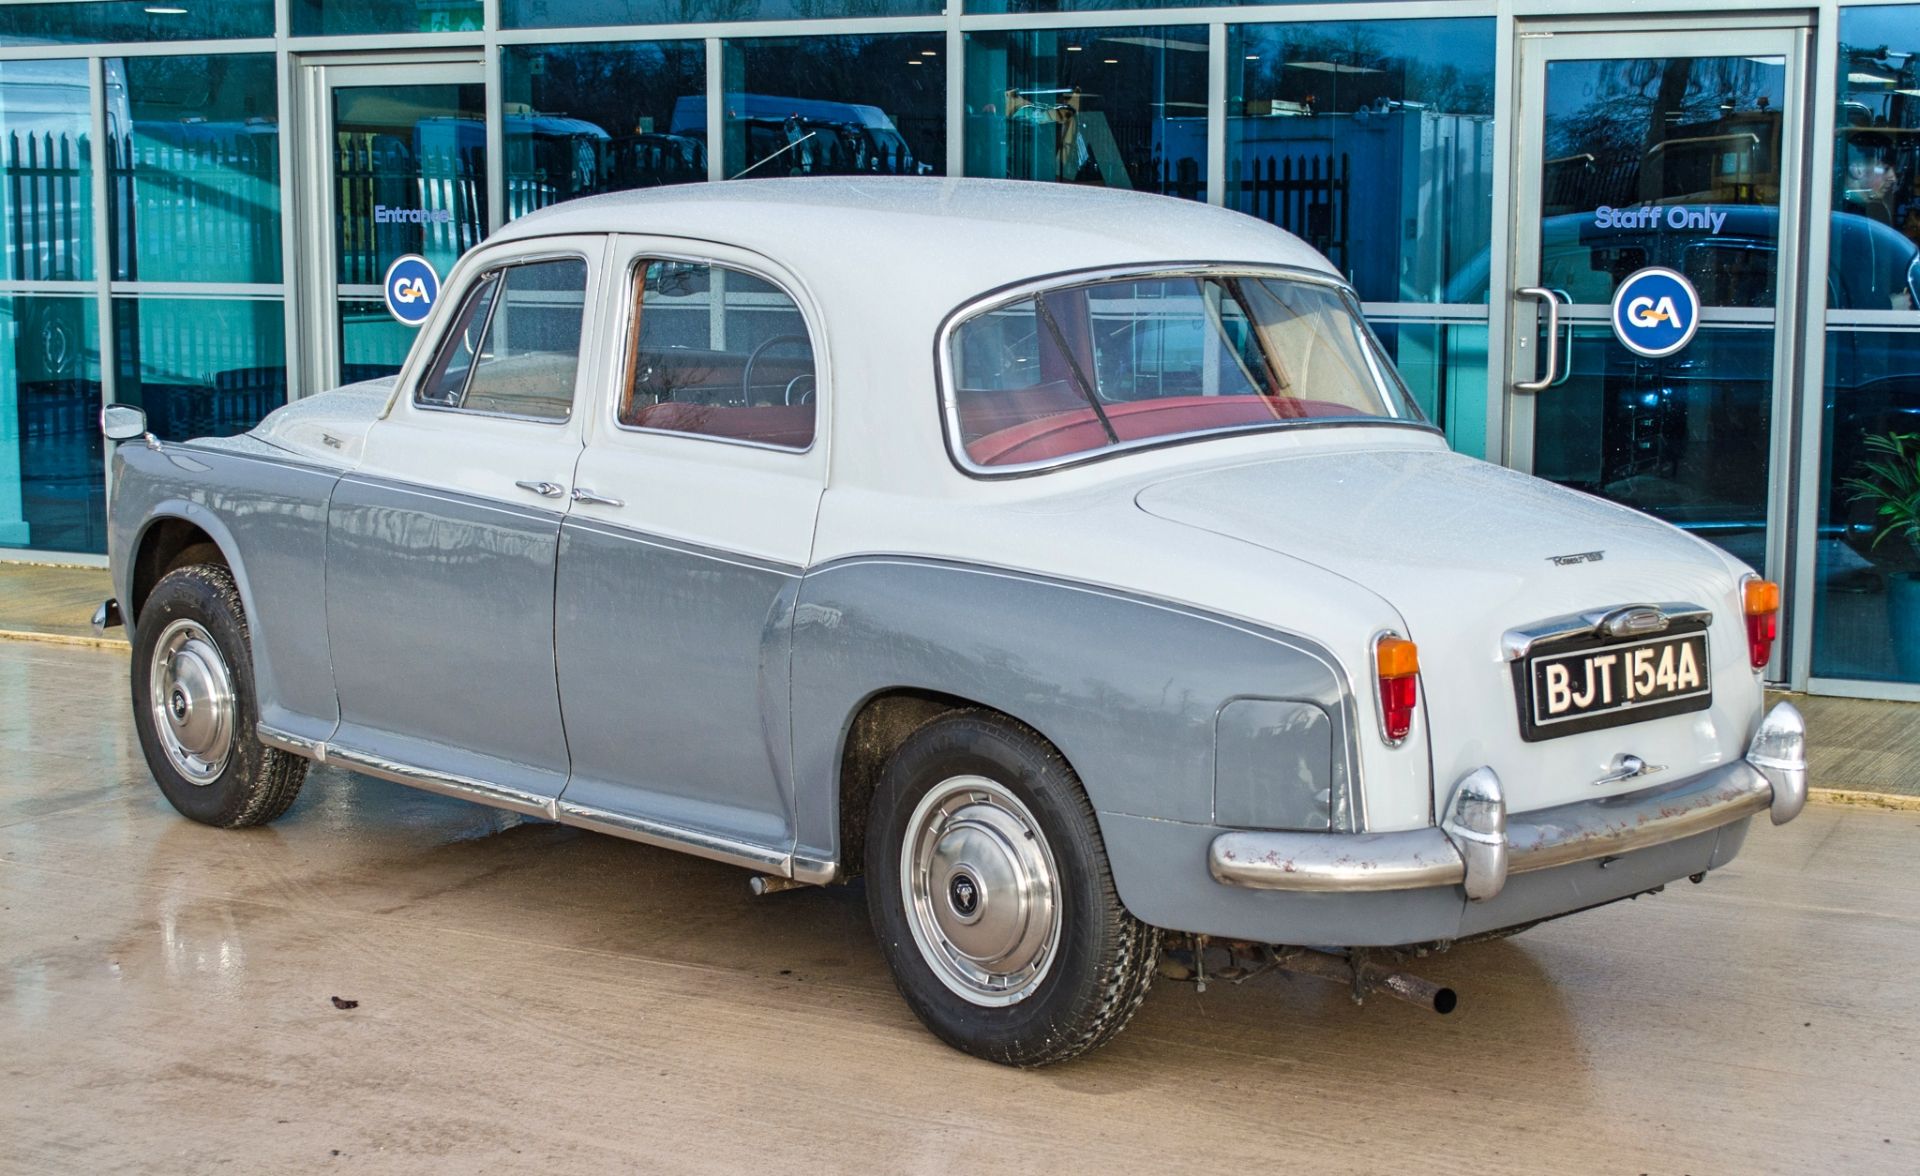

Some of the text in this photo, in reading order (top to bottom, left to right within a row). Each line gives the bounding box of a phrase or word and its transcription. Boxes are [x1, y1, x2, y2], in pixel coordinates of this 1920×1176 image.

[374, 204, 450, 223] Entrance
[1594, 205, 1727, 235] Staff Only
[393, 277, 431, 304] GA
[1627, 296, 1682, 328] GA
[1546, 641, 1701, 714] BJT 154A
